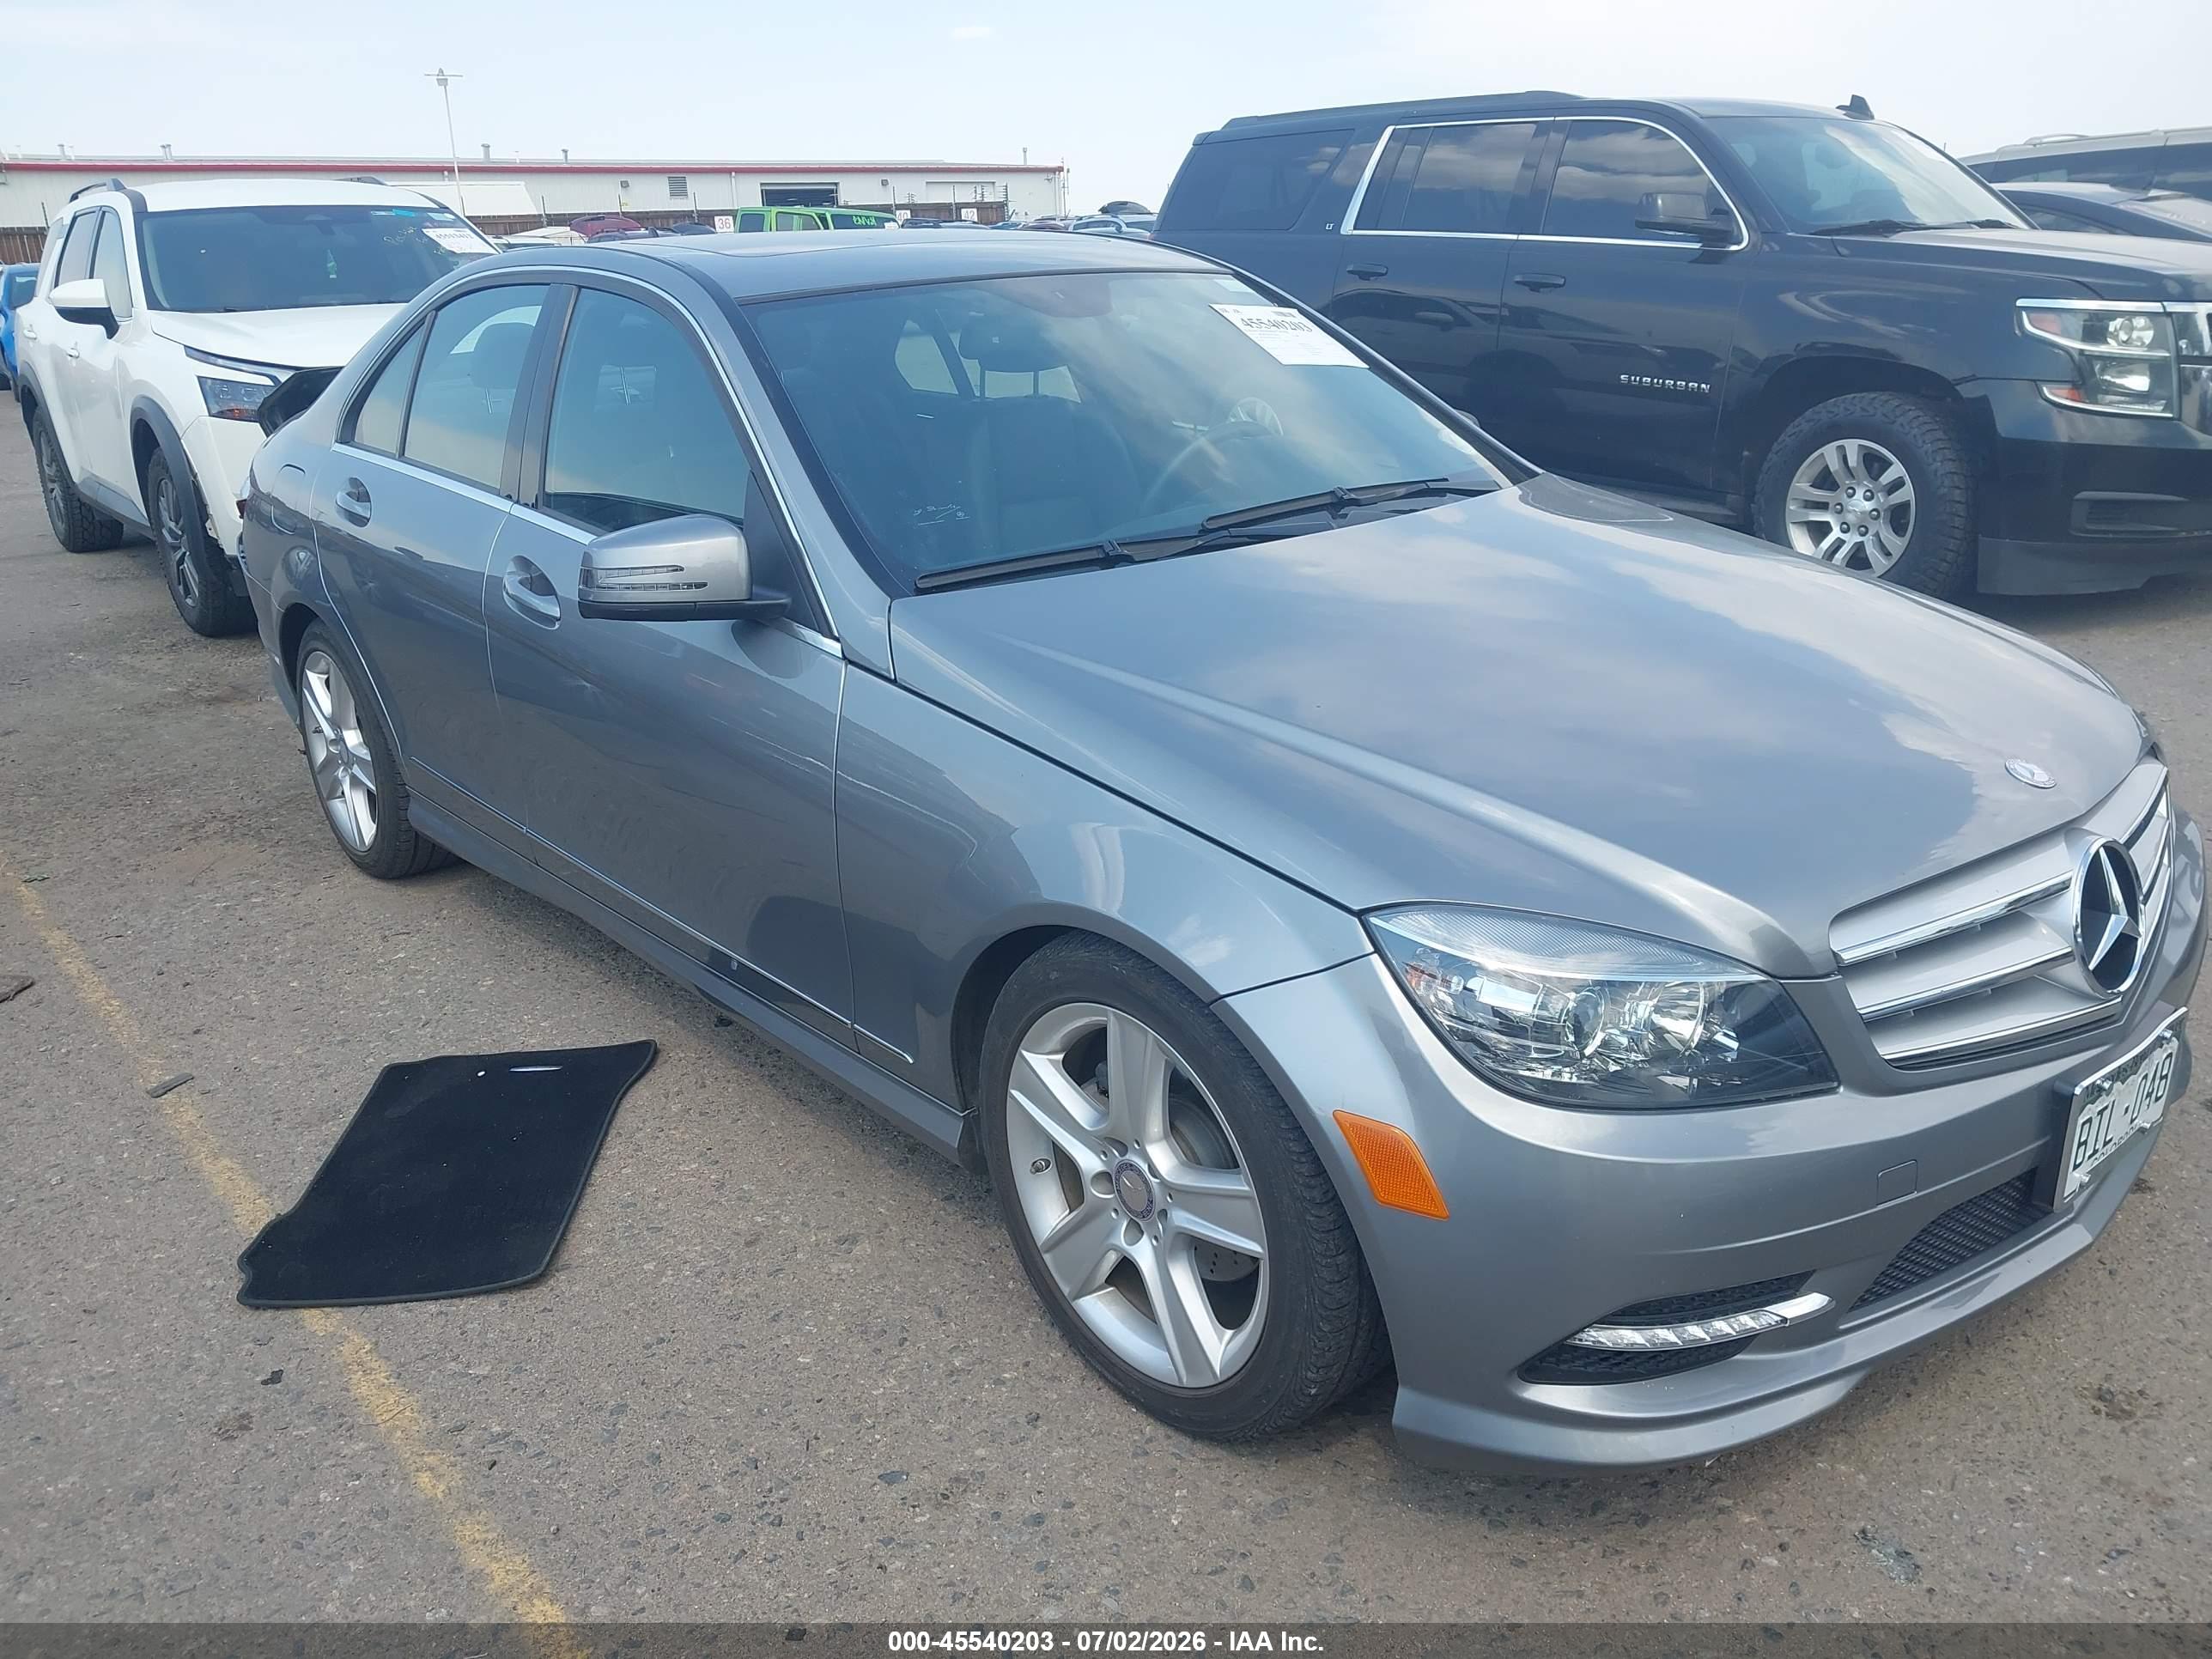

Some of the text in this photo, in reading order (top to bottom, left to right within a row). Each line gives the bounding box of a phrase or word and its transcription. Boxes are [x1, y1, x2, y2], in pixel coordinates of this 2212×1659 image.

[963, 210, 975, 220] 42
[719, 217, 731, 229] 36
[1241, 317, 1313, 332] 45540203
[1620, 374, 1711, 393] SUBURBAN
